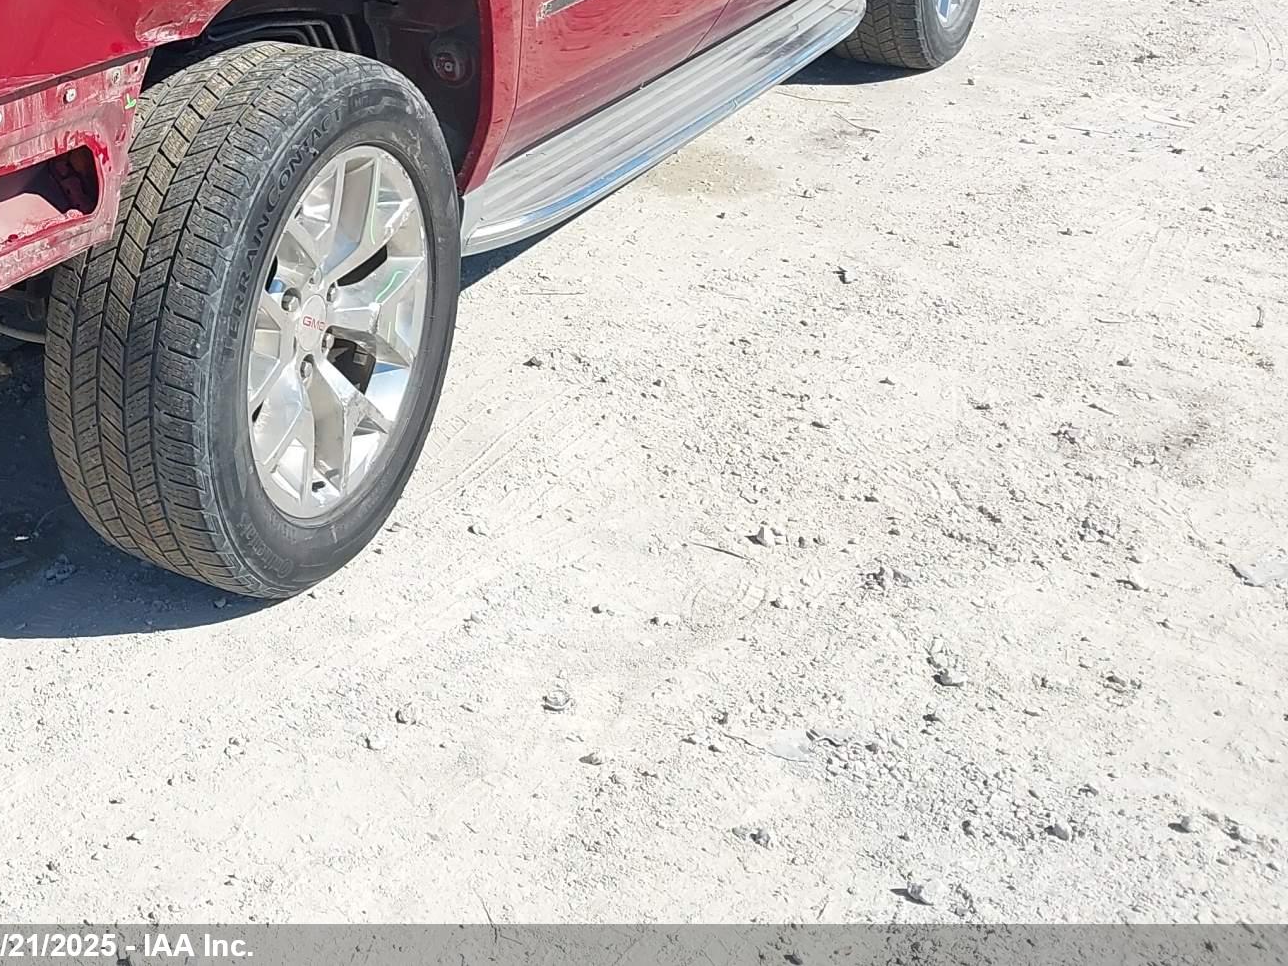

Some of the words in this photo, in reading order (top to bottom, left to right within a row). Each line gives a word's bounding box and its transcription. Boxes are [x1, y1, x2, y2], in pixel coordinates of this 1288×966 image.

[221, 208, 272, 359] TERRAIN
[265, 104, 343, 214] CONTACT
[302, 315, 326, 332] GMC
